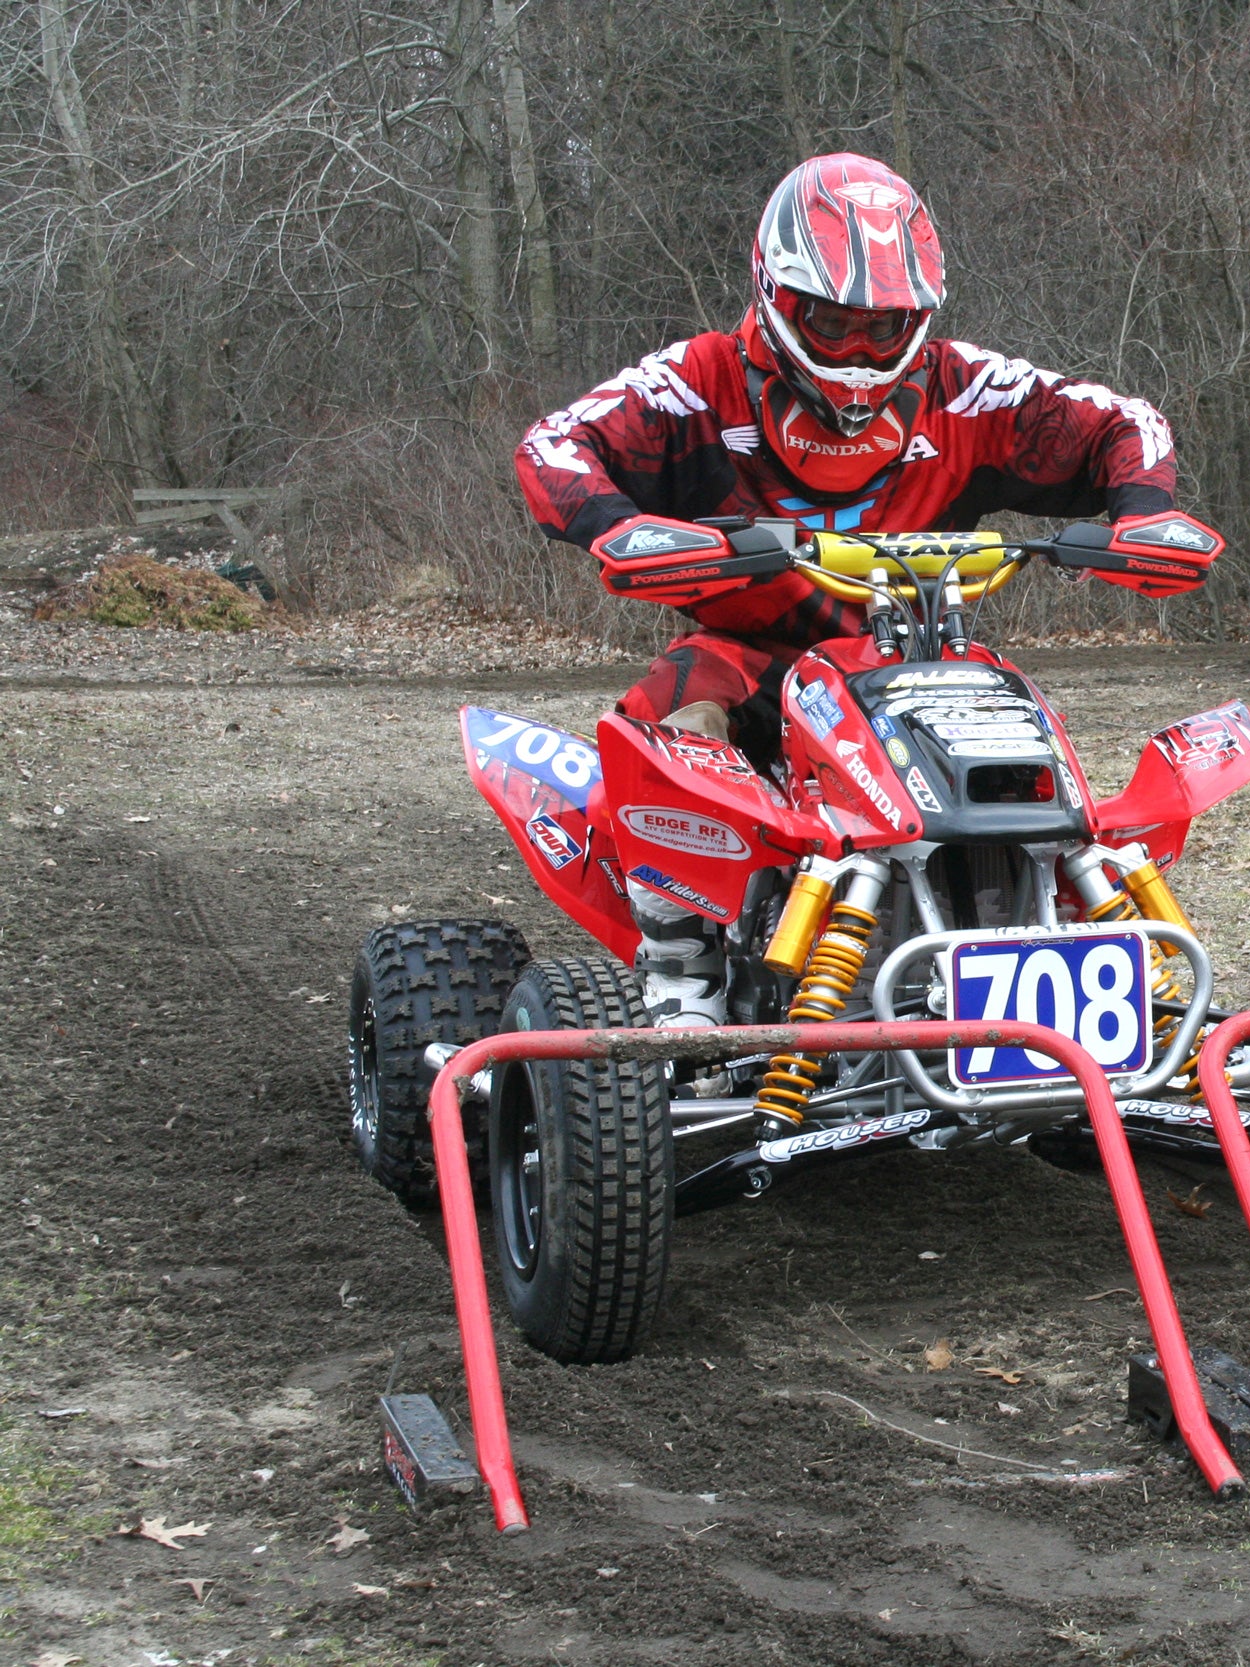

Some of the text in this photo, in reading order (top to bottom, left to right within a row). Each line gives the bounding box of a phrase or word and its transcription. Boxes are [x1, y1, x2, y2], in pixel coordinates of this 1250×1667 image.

[788, 435, 875, 456] HONDA
[477, 714, 598, 788] 708
[846, 754, 902, 832] HONDA
[530, 821, 575, 858] DWT
[641, 831, 728, 853] www.edgetyres.co.uk
[643, 814, 728, 841] EDGE RF1
[710, 838, 728, 847] TYRE
[629, 864, 729, 917] ATVriders.com
[959, 943, 1139, 1074] 708
[788, 1110, 929, 1153] HOUSER
